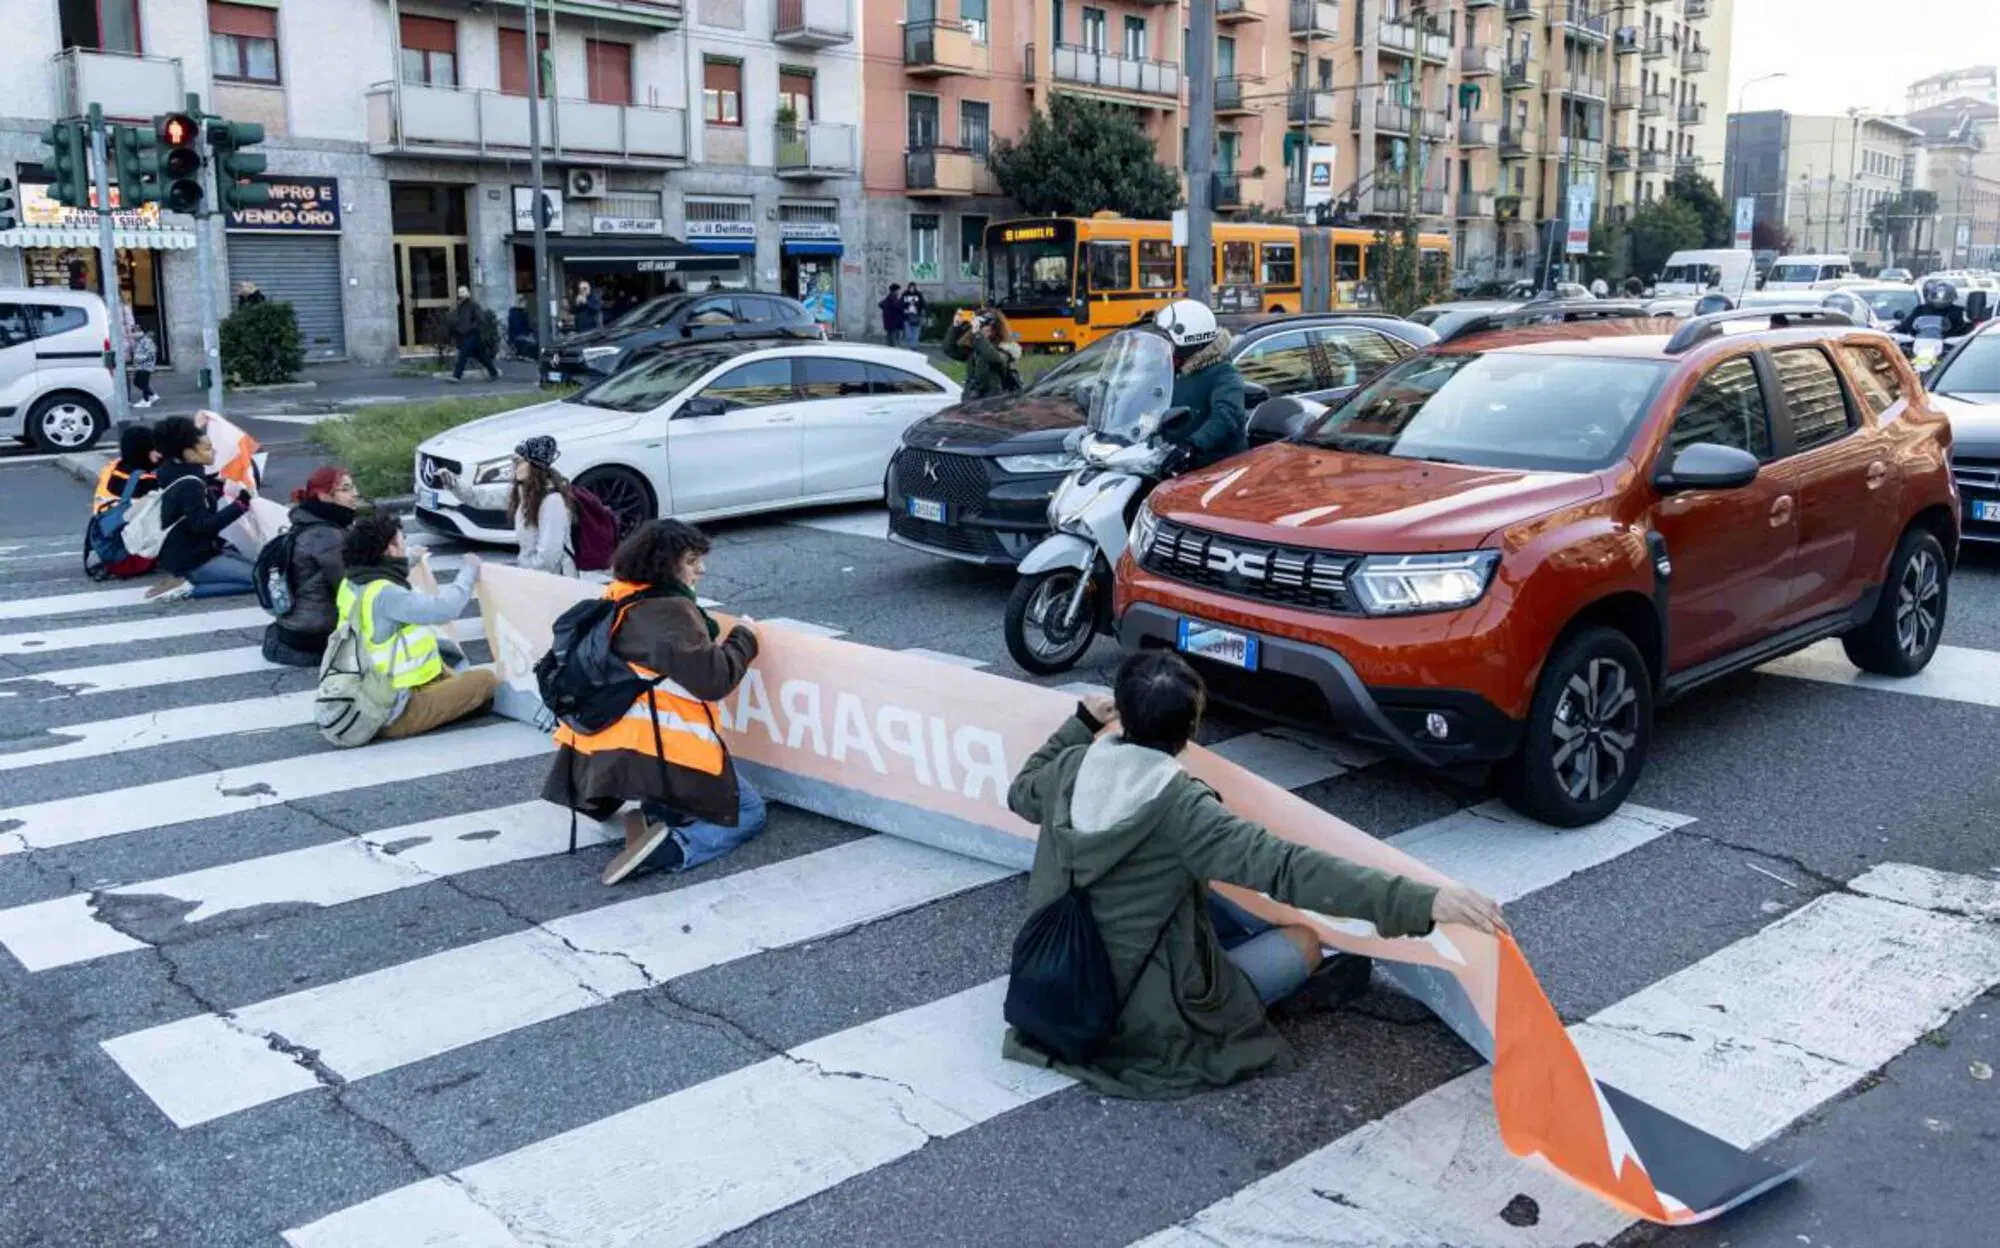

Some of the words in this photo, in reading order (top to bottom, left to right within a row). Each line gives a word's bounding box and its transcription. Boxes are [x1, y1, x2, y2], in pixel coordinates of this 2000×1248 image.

[267, 184, 315, 199] MPRO
[320, 186, 332, 200] E
[232, 210, 295, 224] VENDO
[297, 211, 334, 225] ORO
